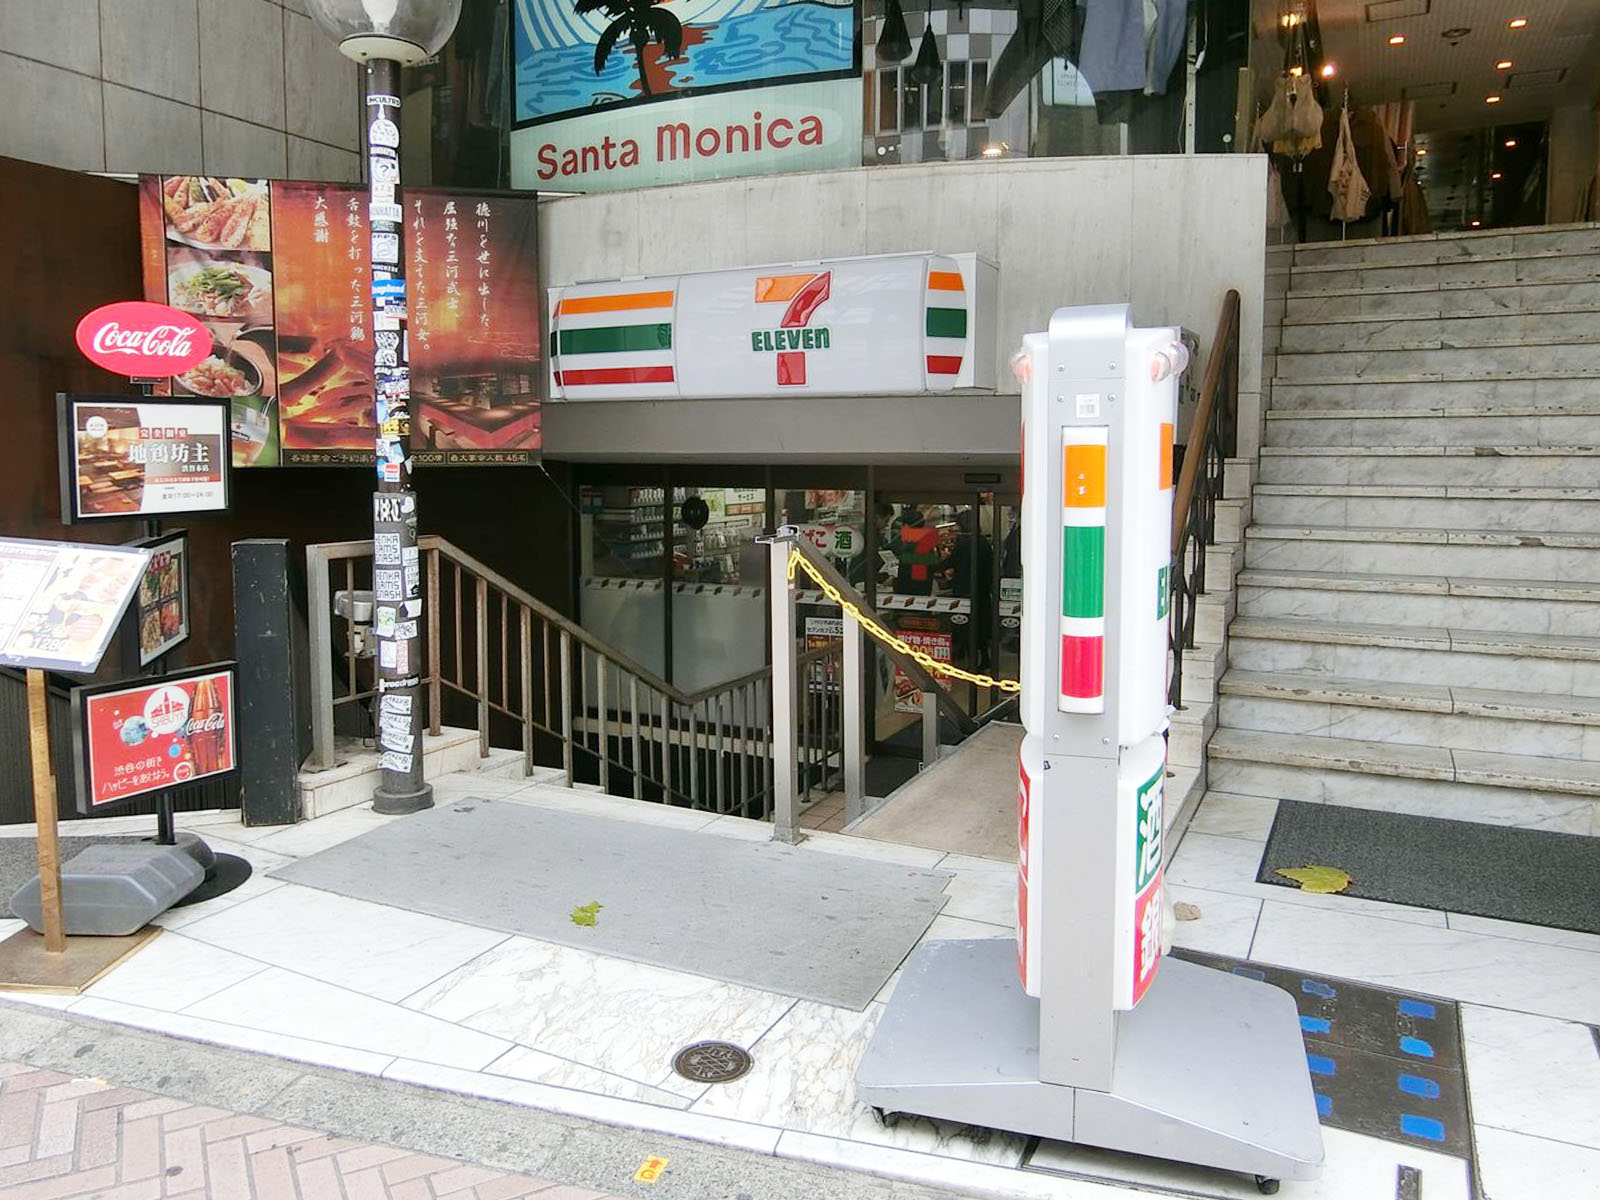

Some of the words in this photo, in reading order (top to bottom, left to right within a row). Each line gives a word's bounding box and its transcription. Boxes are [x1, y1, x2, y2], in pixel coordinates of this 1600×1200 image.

[536, 135, 640, 180] Santa
[656, 111, 824, 162] Monica
[93, 321, 198, 358] Coca-Cola
[834, 530, 853, 550] 酒
